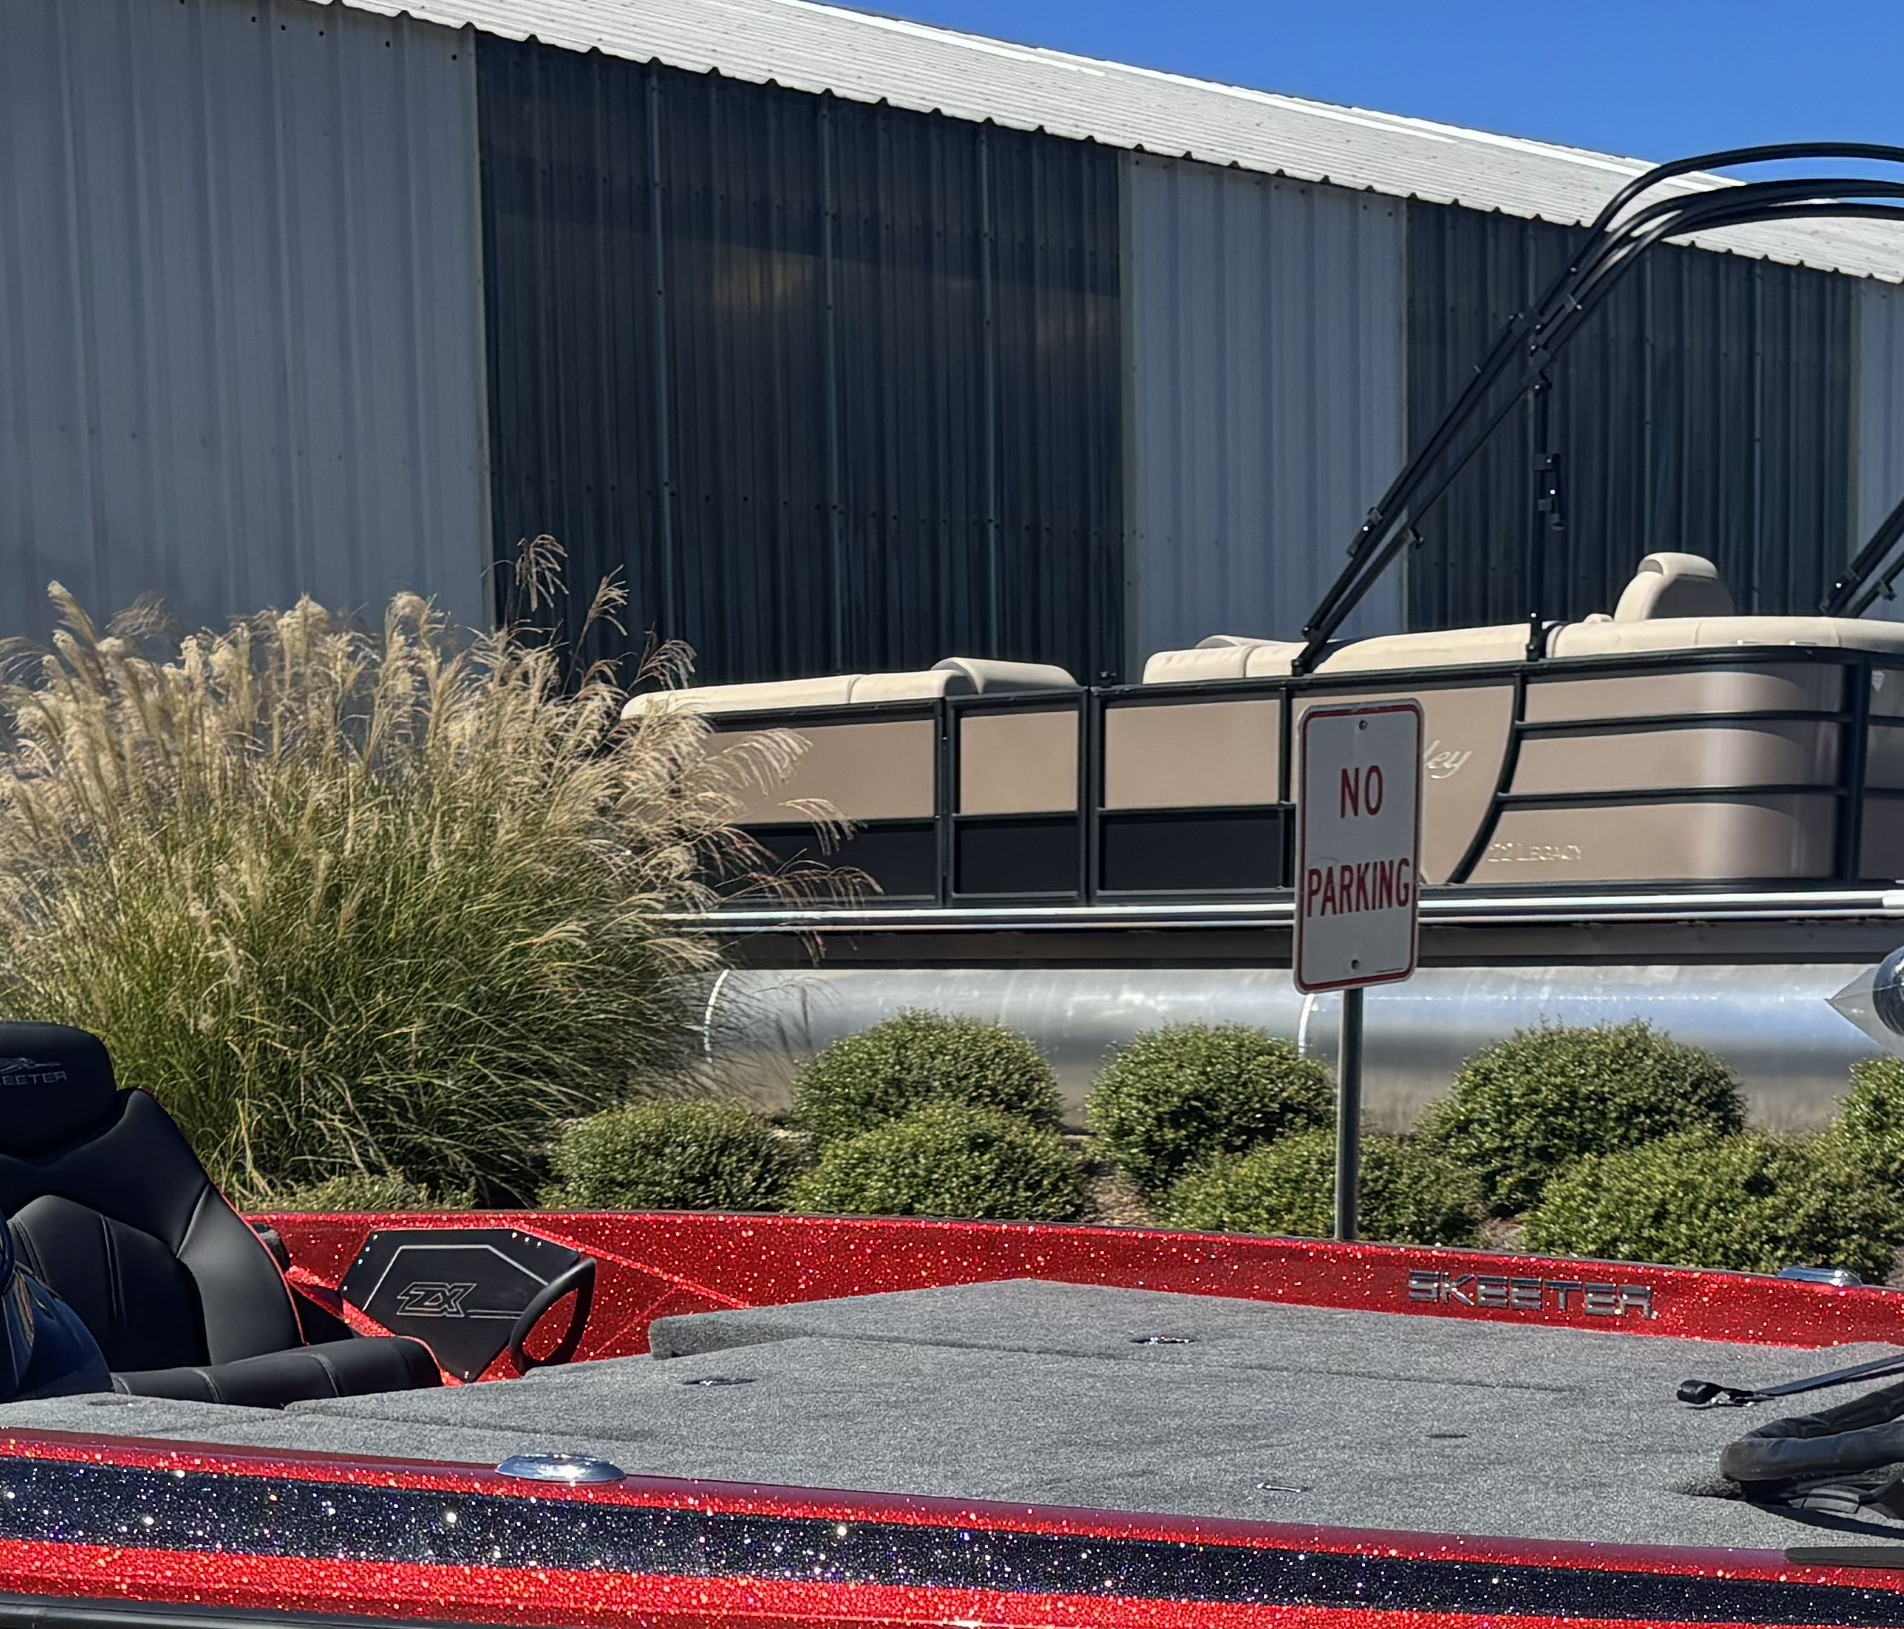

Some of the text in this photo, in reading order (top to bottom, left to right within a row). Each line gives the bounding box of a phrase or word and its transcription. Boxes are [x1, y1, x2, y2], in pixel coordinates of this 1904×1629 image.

[1340, 764, 1384, 818] NO
[1306, 857, 1411, 918] PARKING
[396, 1281, 478, 1318] ZX
[1408, 1269, 1658, 1320] SKEETER
